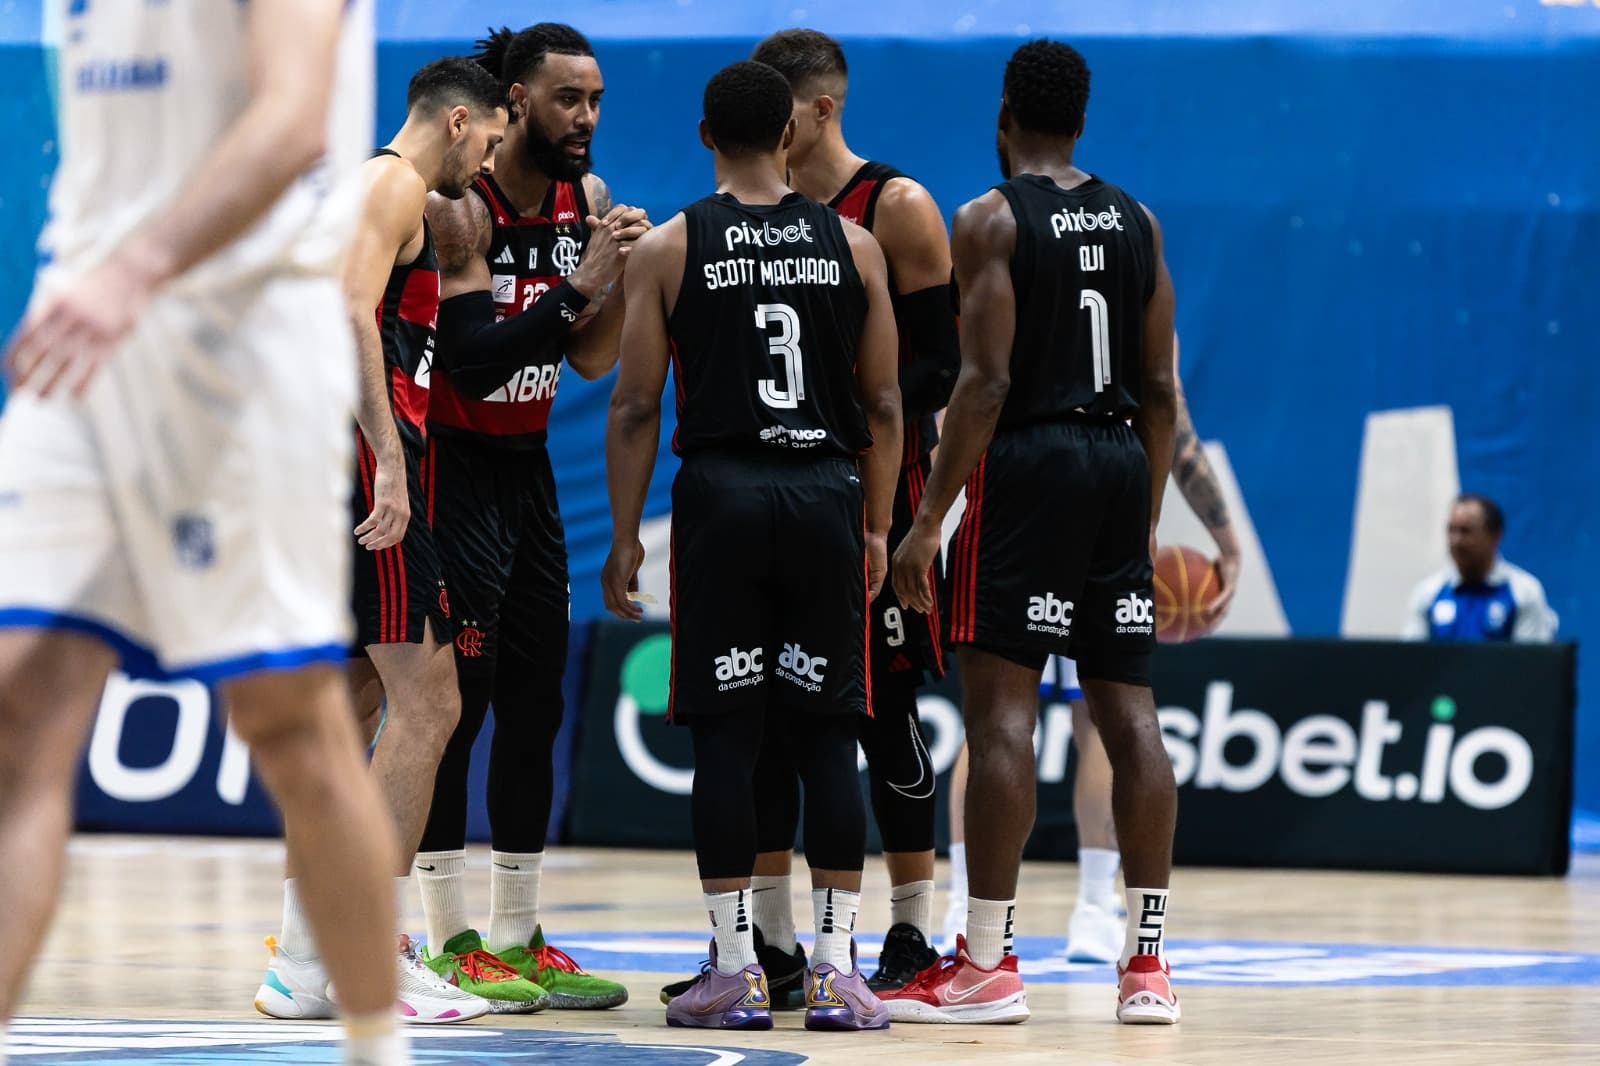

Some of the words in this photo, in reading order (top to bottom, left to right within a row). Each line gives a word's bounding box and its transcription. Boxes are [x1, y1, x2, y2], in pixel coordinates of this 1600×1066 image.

[725, 218, 814, 252] pixbet
[1051, 206, 1124, 239] pixbet
[704, 258, 755, 290] SCOTT
[760, 257, 840, 286] MACHADO
[755, 303, 805, 409] 3
[1080, 289, 1112, 393] 1
[1027, 592, 1075, 627] abc
[1115, 592, 1154, 624] abc
[884, 606, 906, 648] 9
[714, 646, 764, 681] abc
[778, 642, 828, 683] abc
[718, 682, 729, 692] da
[729, 674, 764, 689] construção
[785, 672, 822, 692] construção
